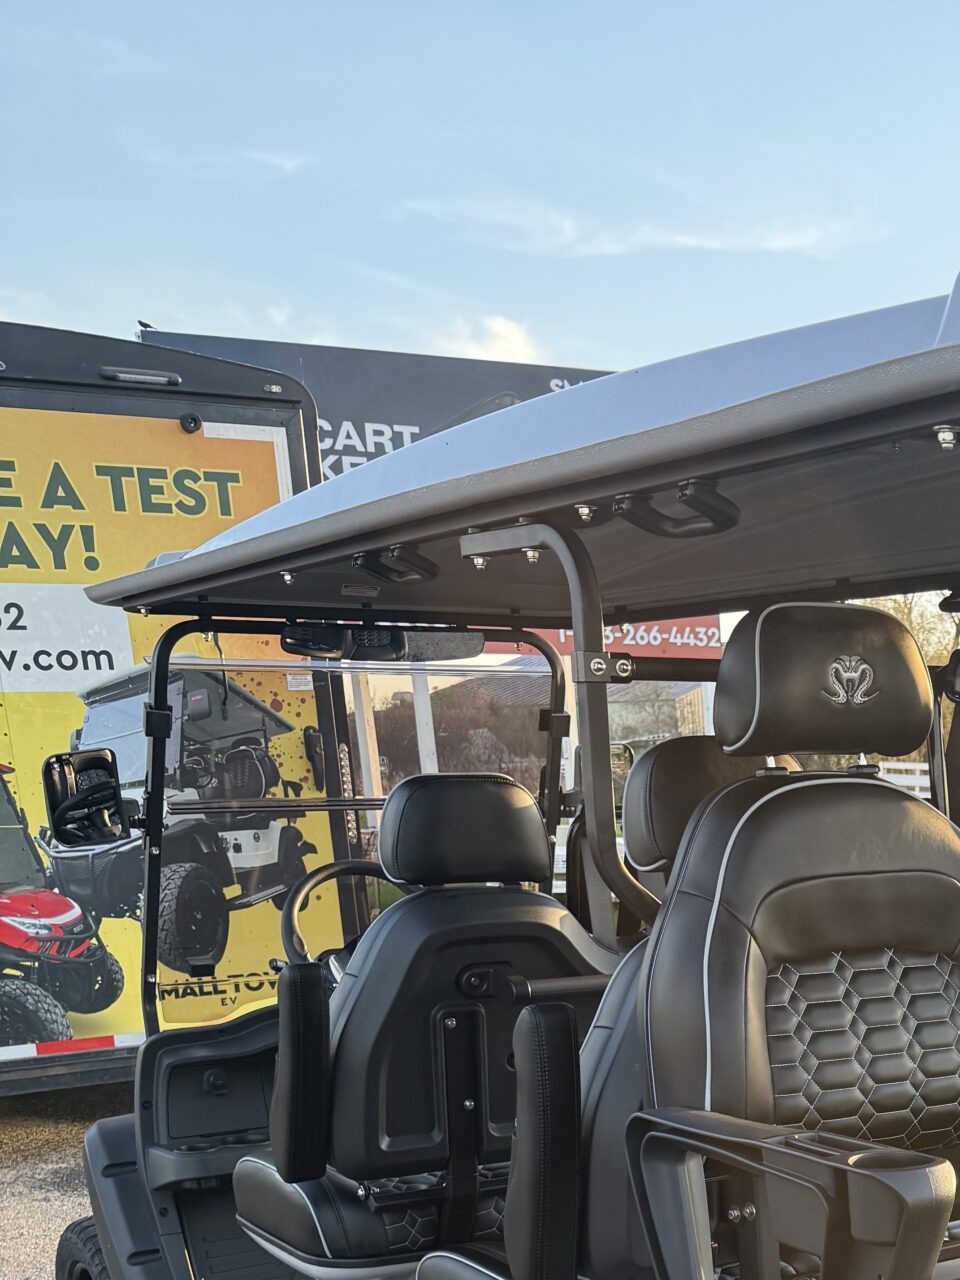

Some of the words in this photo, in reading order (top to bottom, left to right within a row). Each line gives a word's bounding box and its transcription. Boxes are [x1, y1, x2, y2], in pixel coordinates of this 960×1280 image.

[319, 418, 420, 453] CART
[40, 461, 86, 511] A
[94, 464, 241, 517] TEST
[160, 976, 227, 1001] MALL
[221, 996, 238, 1007] EV
